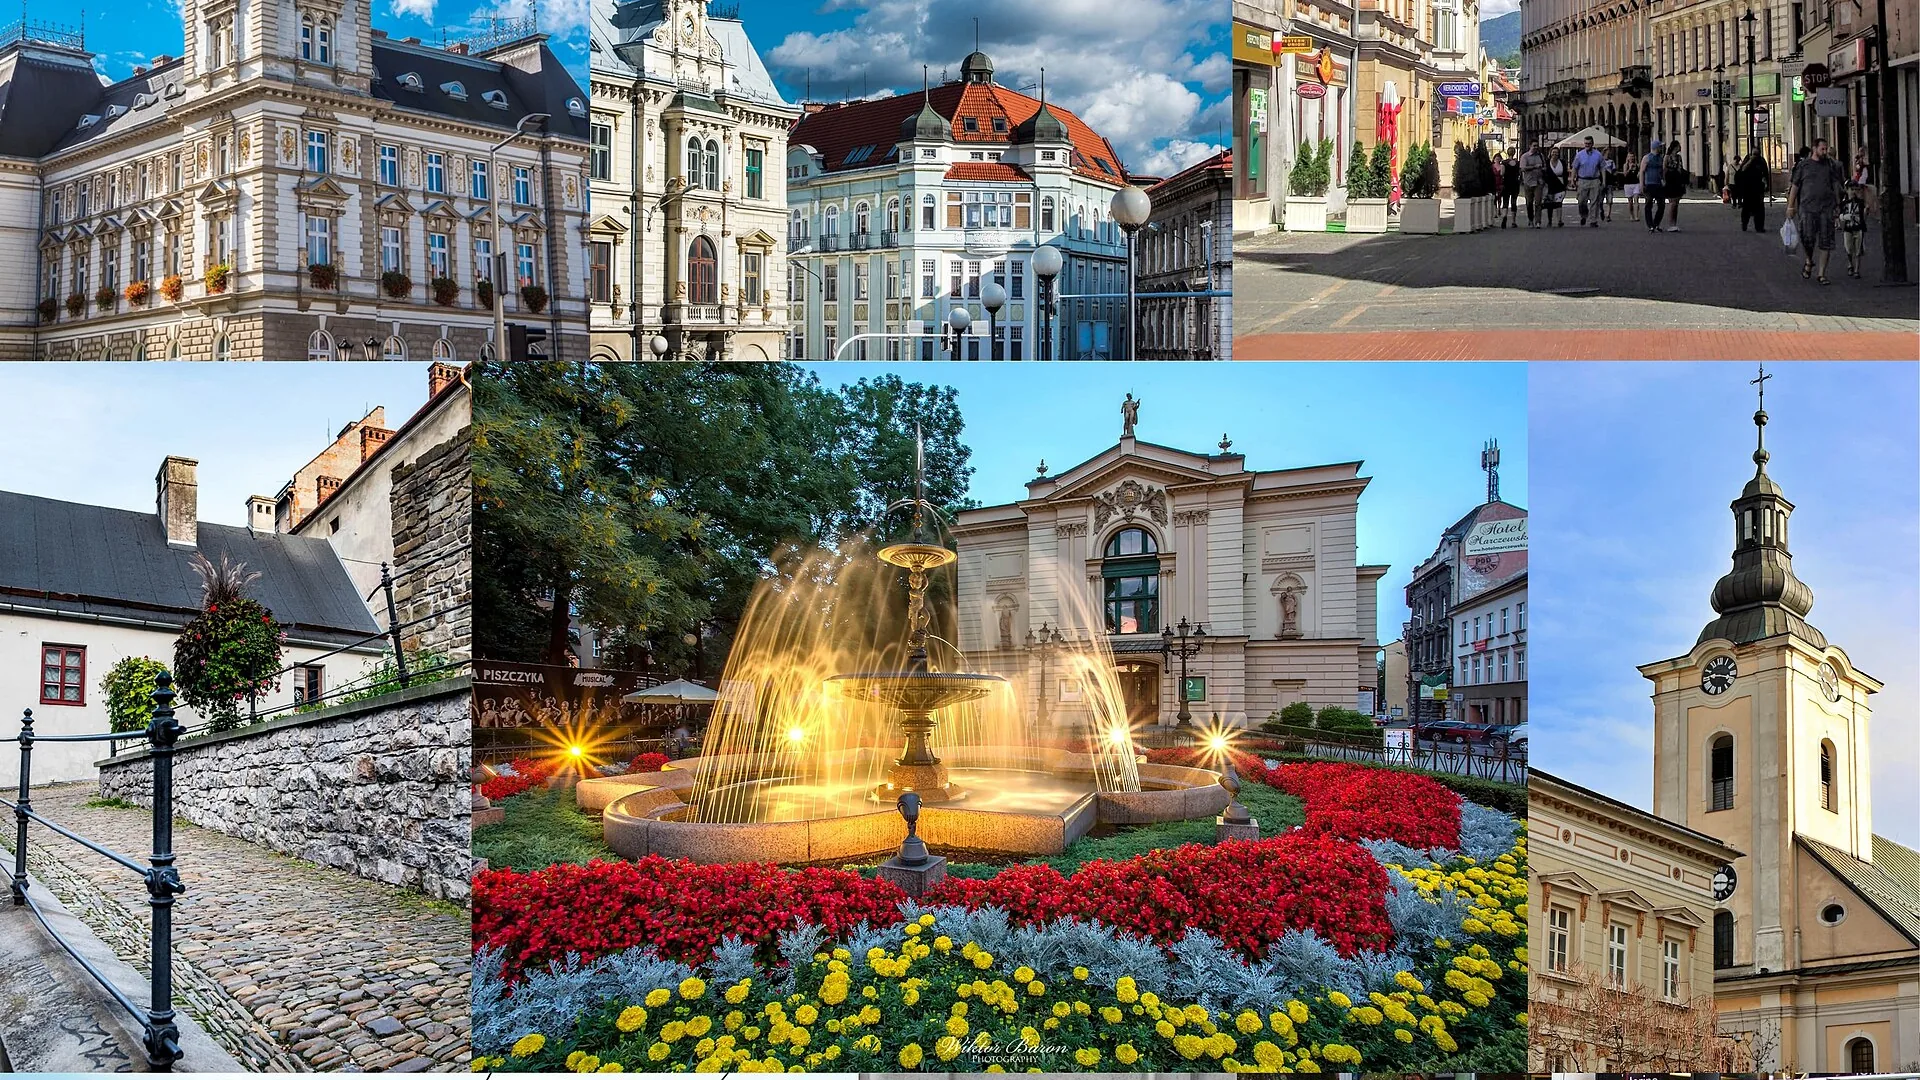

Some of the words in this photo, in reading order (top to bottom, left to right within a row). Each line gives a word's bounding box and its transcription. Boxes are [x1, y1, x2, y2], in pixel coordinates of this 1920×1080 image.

[1804, 73, 1829, 84] STOP
[1480, 519, 1526, 535] Hotel
[483, 669, 545, 684] PISZCZYKA
[582, 674, 606, 683] MUSICAL
